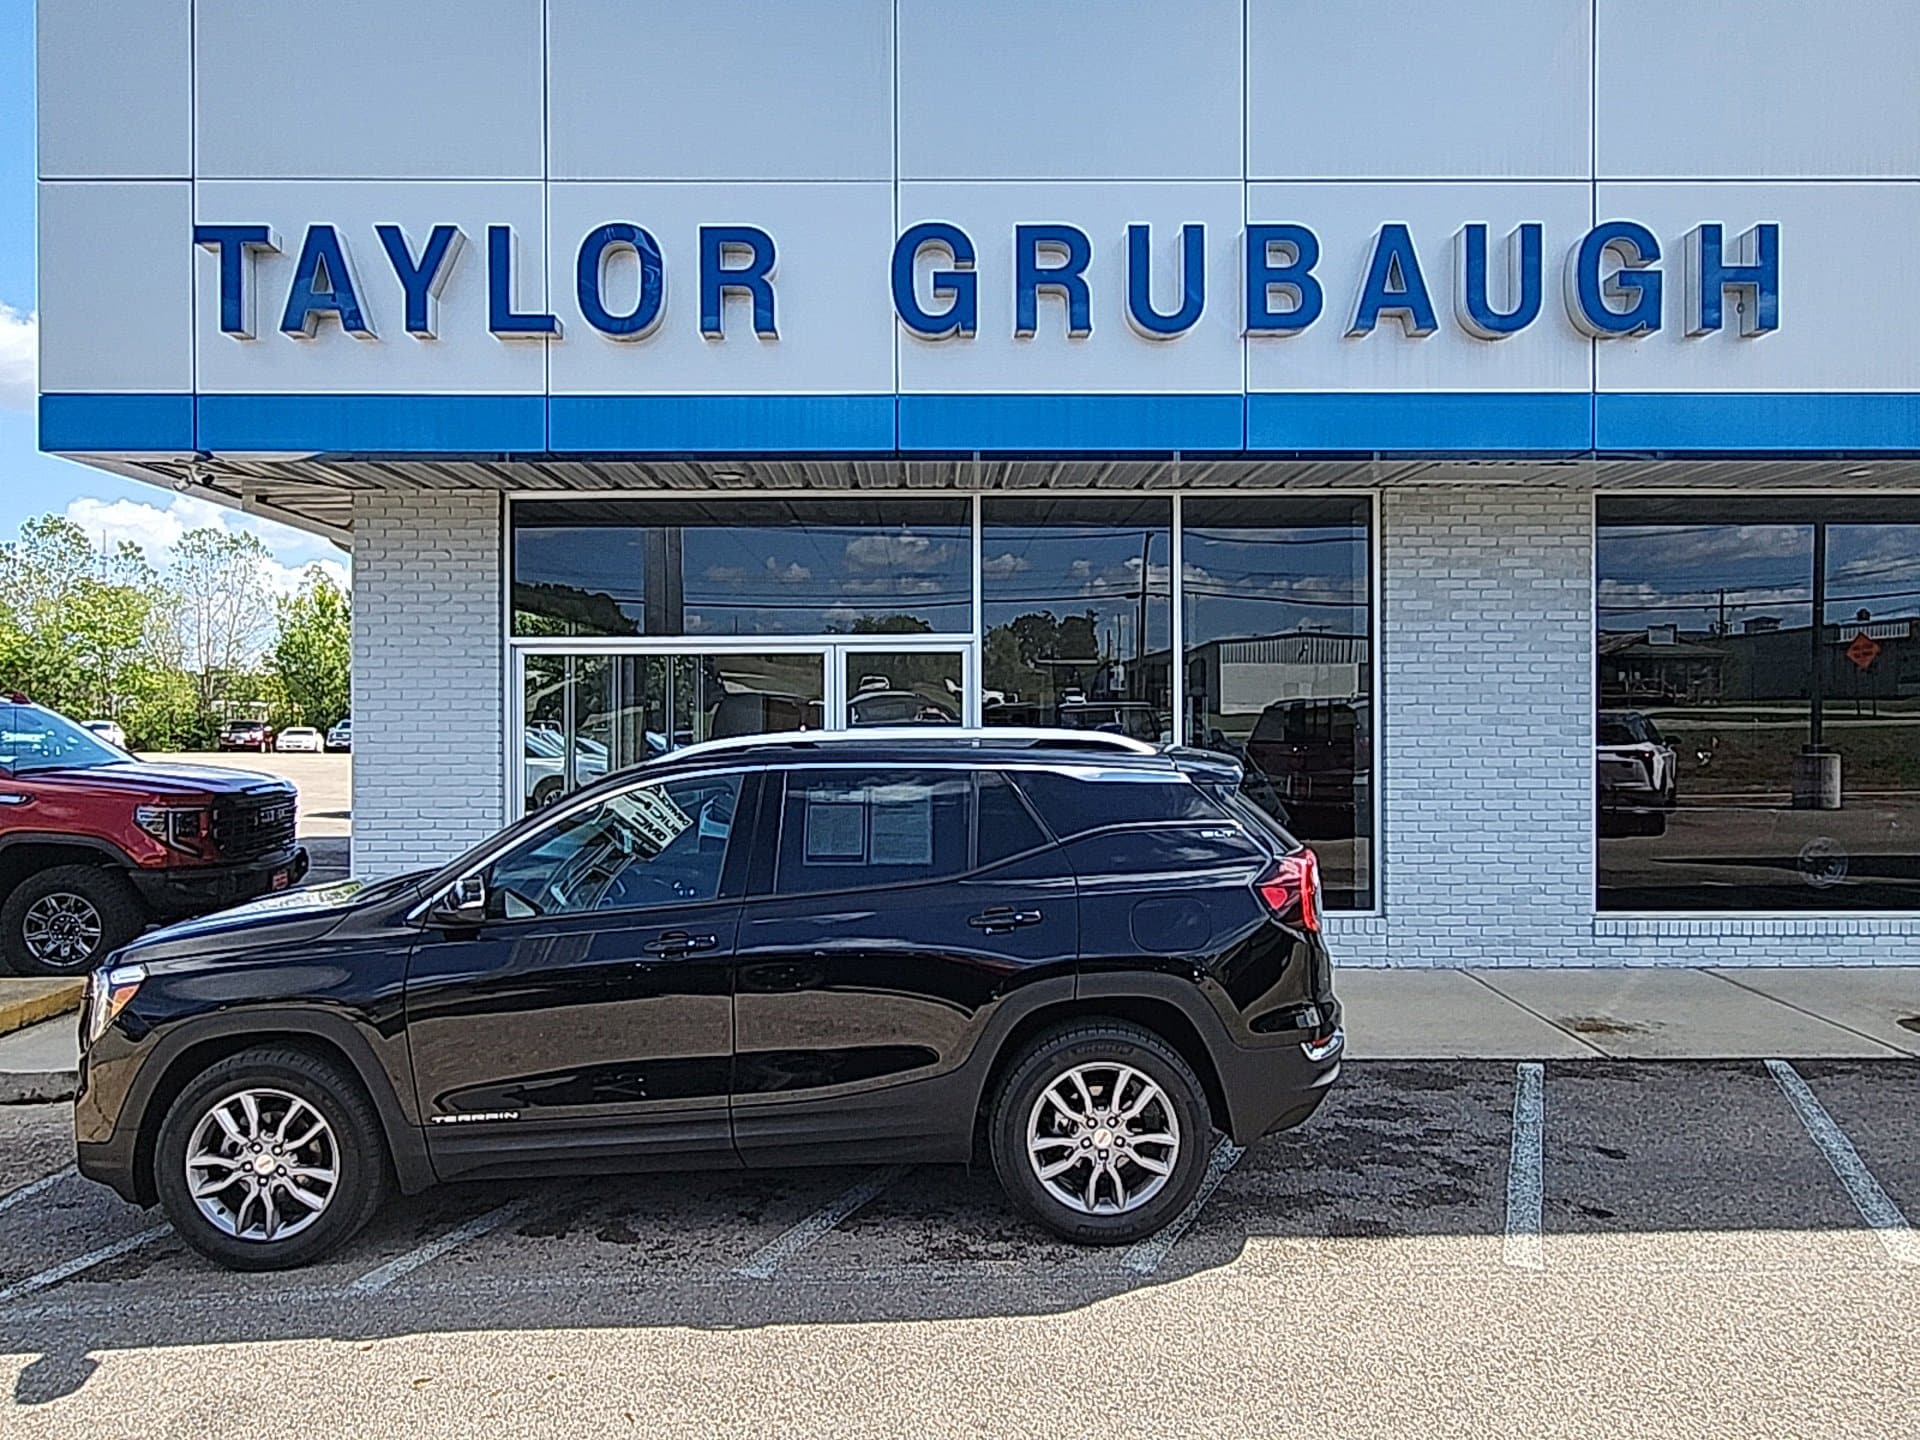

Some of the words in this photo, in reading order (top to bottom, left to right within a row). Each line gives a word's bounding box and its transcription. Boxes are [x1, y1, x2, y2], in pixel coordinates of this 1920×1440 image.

[193, 222, 778, 341] TAYLOR
[891, 222, 1780, 340] GRUBAUGH
[431, 1111, 518, 1123] TERRAIN
